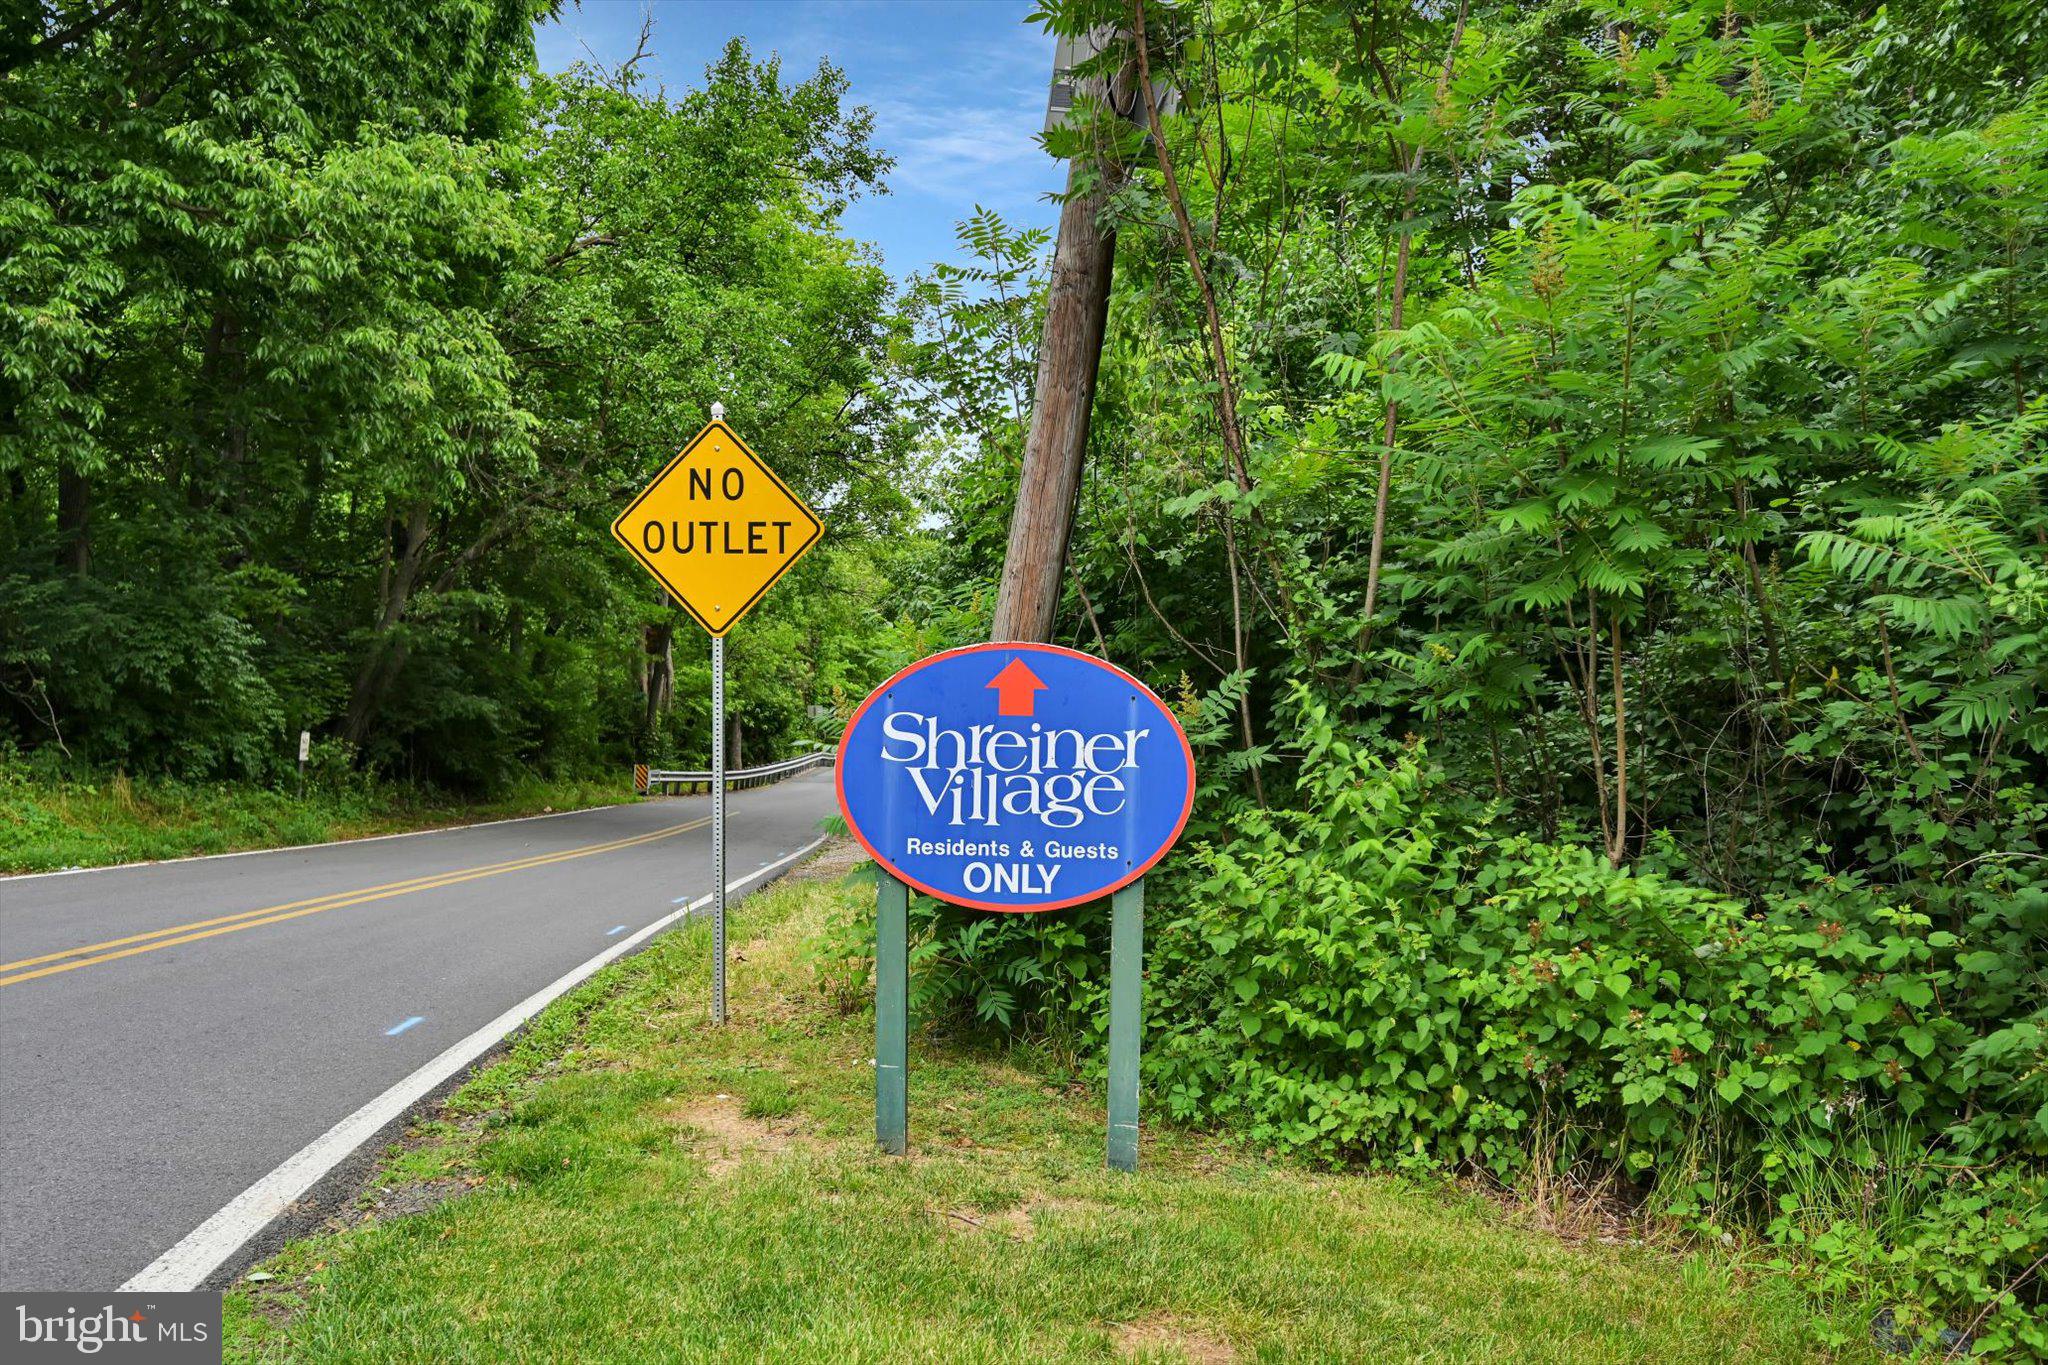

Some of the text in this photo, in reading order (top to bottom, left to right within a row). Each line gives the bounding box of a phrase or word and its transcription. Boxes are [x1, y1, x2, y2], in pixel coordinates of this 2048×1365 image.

[689, 467, 744, 501] NO
[643, 520, 792, 555] OUTLET
[880, 711, 1150, 775] Shreiner
[905, 766, 1126, 828] Village
[907, 838, 1119, 860] Residents & Guests
[963, 861, 1062, 894] ONLY
